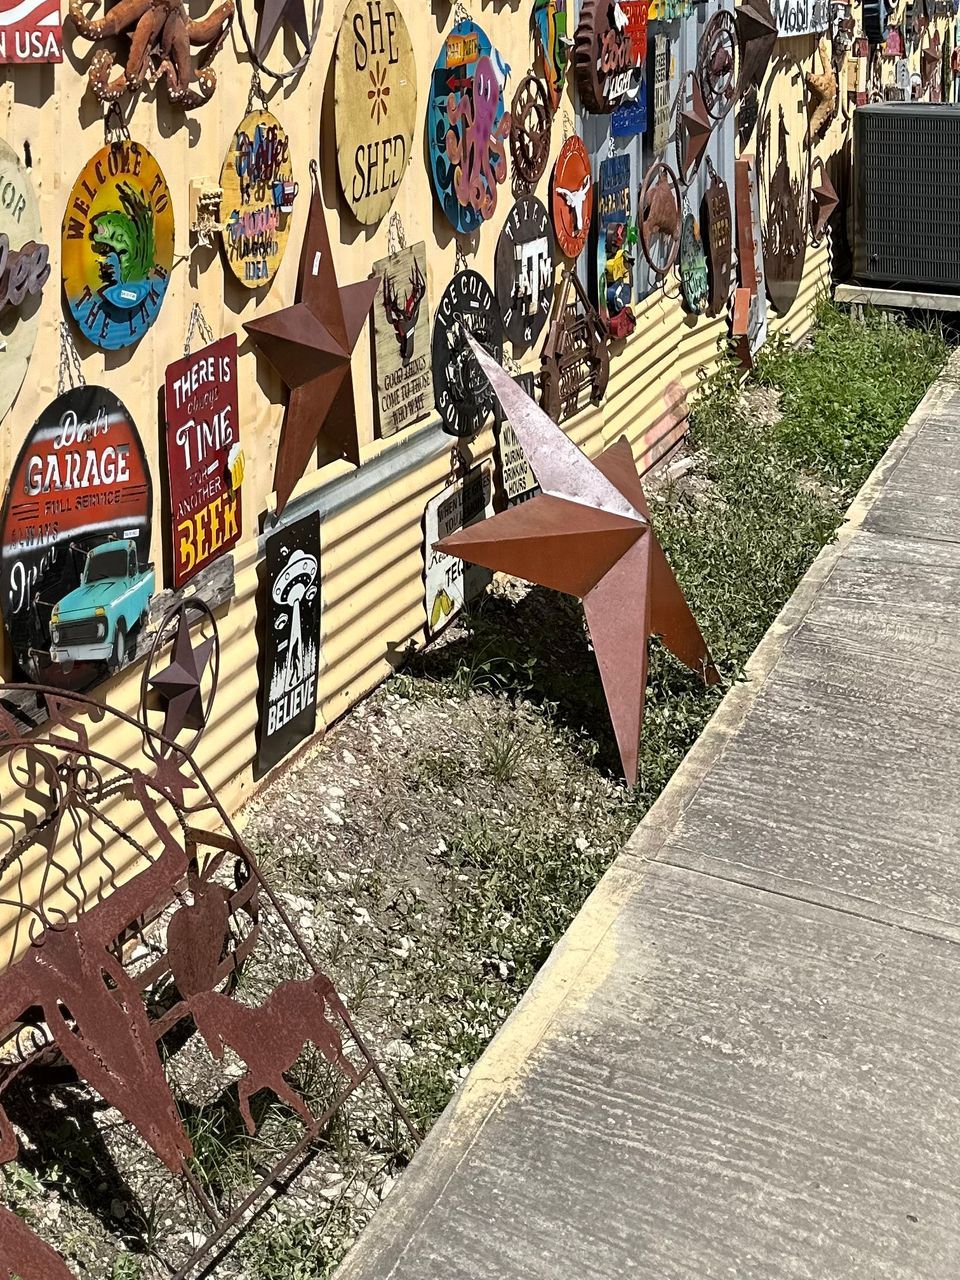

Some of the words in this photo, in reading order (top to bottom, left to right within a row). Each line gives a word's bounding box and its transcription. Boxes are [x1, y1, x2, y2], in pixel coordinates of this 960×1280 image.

[13, 30, 60, 59] USA
[351, 0, 401, 72] SHE
[351, 133, 407, 205] SHED
[66, 149, 143, 240] WELCOME
[147, 173, 170, 216] TO
[74, 284, 110, 340] THE
[127, 263, 169, 337] LAKE
[437, 282, 459, 327] ICE
[459, 275, 491, 311] COLD
[173, 356, 215, 409] THERE
[218, 355, 232, 383] IS
[381, 388, 400, 412] COME
[400, 382, 411, 402] TO
[410, 370, 431, 395] THOSE
[384, 366, 404, 391] GOOD
[403, 355, 427, 381] THINGS
[53, 406, 110, 450] Dad's
[392, 404, 409, 426] WHO
[175, 404, 234, 471] TIME
[504, 446, 525, 467] DURING
[23, 442, 131, 497] GARAGE
[189, 463, 208, 487] FOR
[503, 460, 528, 485] DRINKING
[508, 476, 528, 498] HOURS
[44, 497, 73, 516] FULL
[75, 489, 121, 511] SERVICE
[176, 476, 223, 520] ANOTHER
[9, 520, 60, 552] ALWAYS
[177, 492, 239, 578] BEER
[266, 673, 316, 738] BELIEVE
